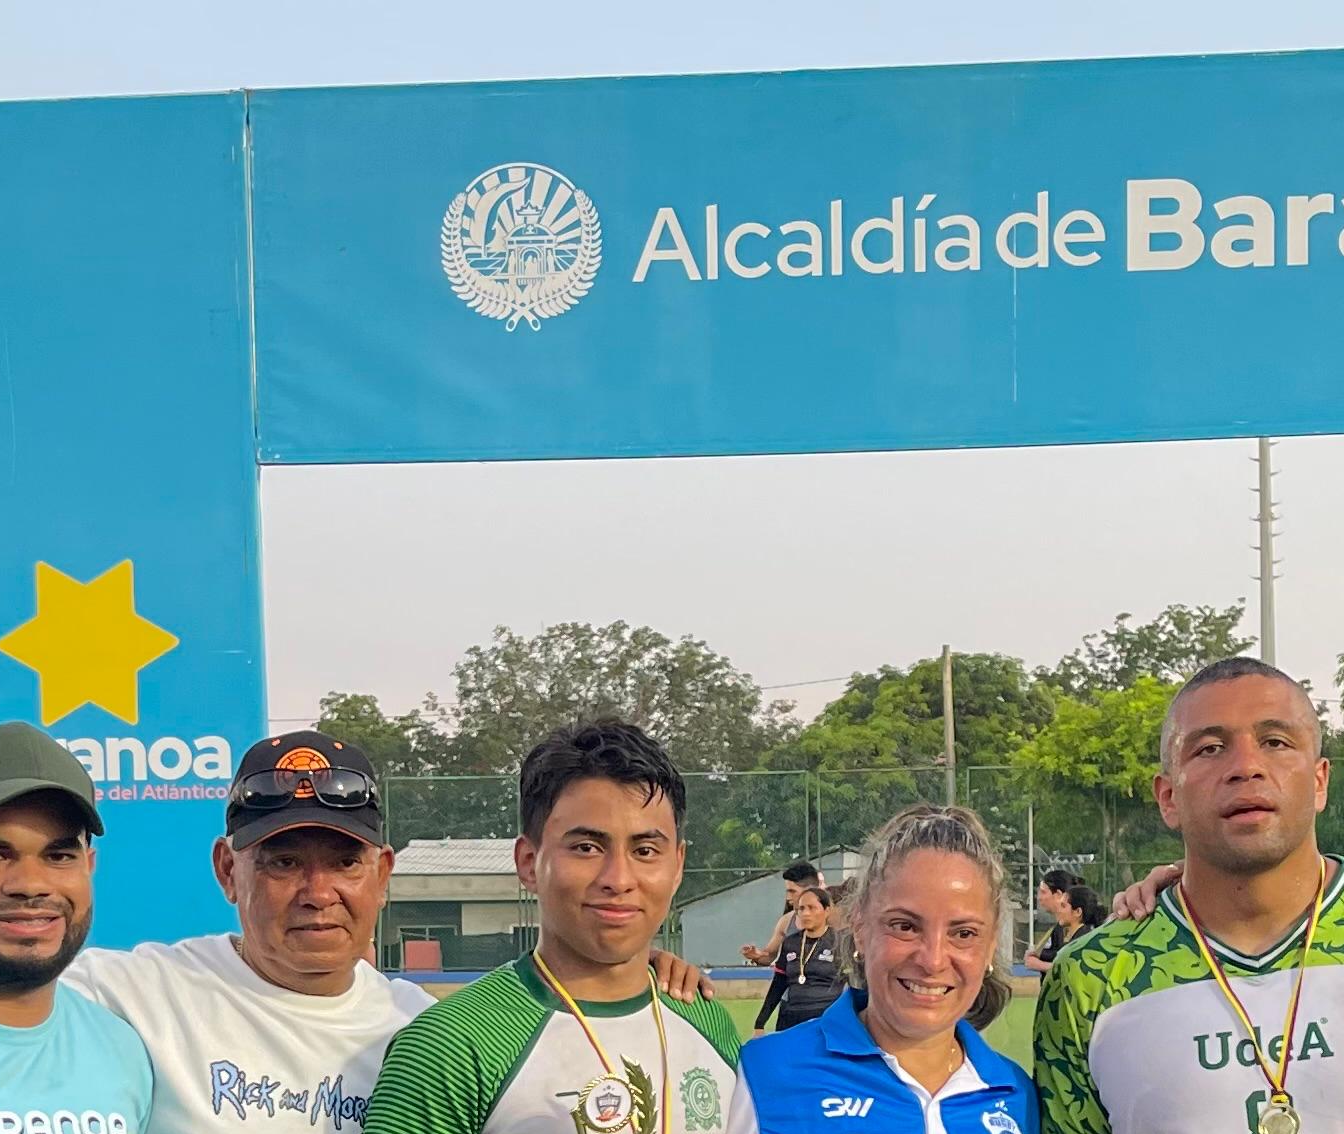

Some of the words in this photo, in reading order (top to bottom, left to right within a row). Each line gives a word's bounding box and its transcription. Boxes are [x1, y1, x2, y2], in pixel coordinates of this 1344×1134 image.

[632, 193, 981, 283] Alcaldía
[995, 190, 1106, 268] de
[108, 784, 137, 801] del
